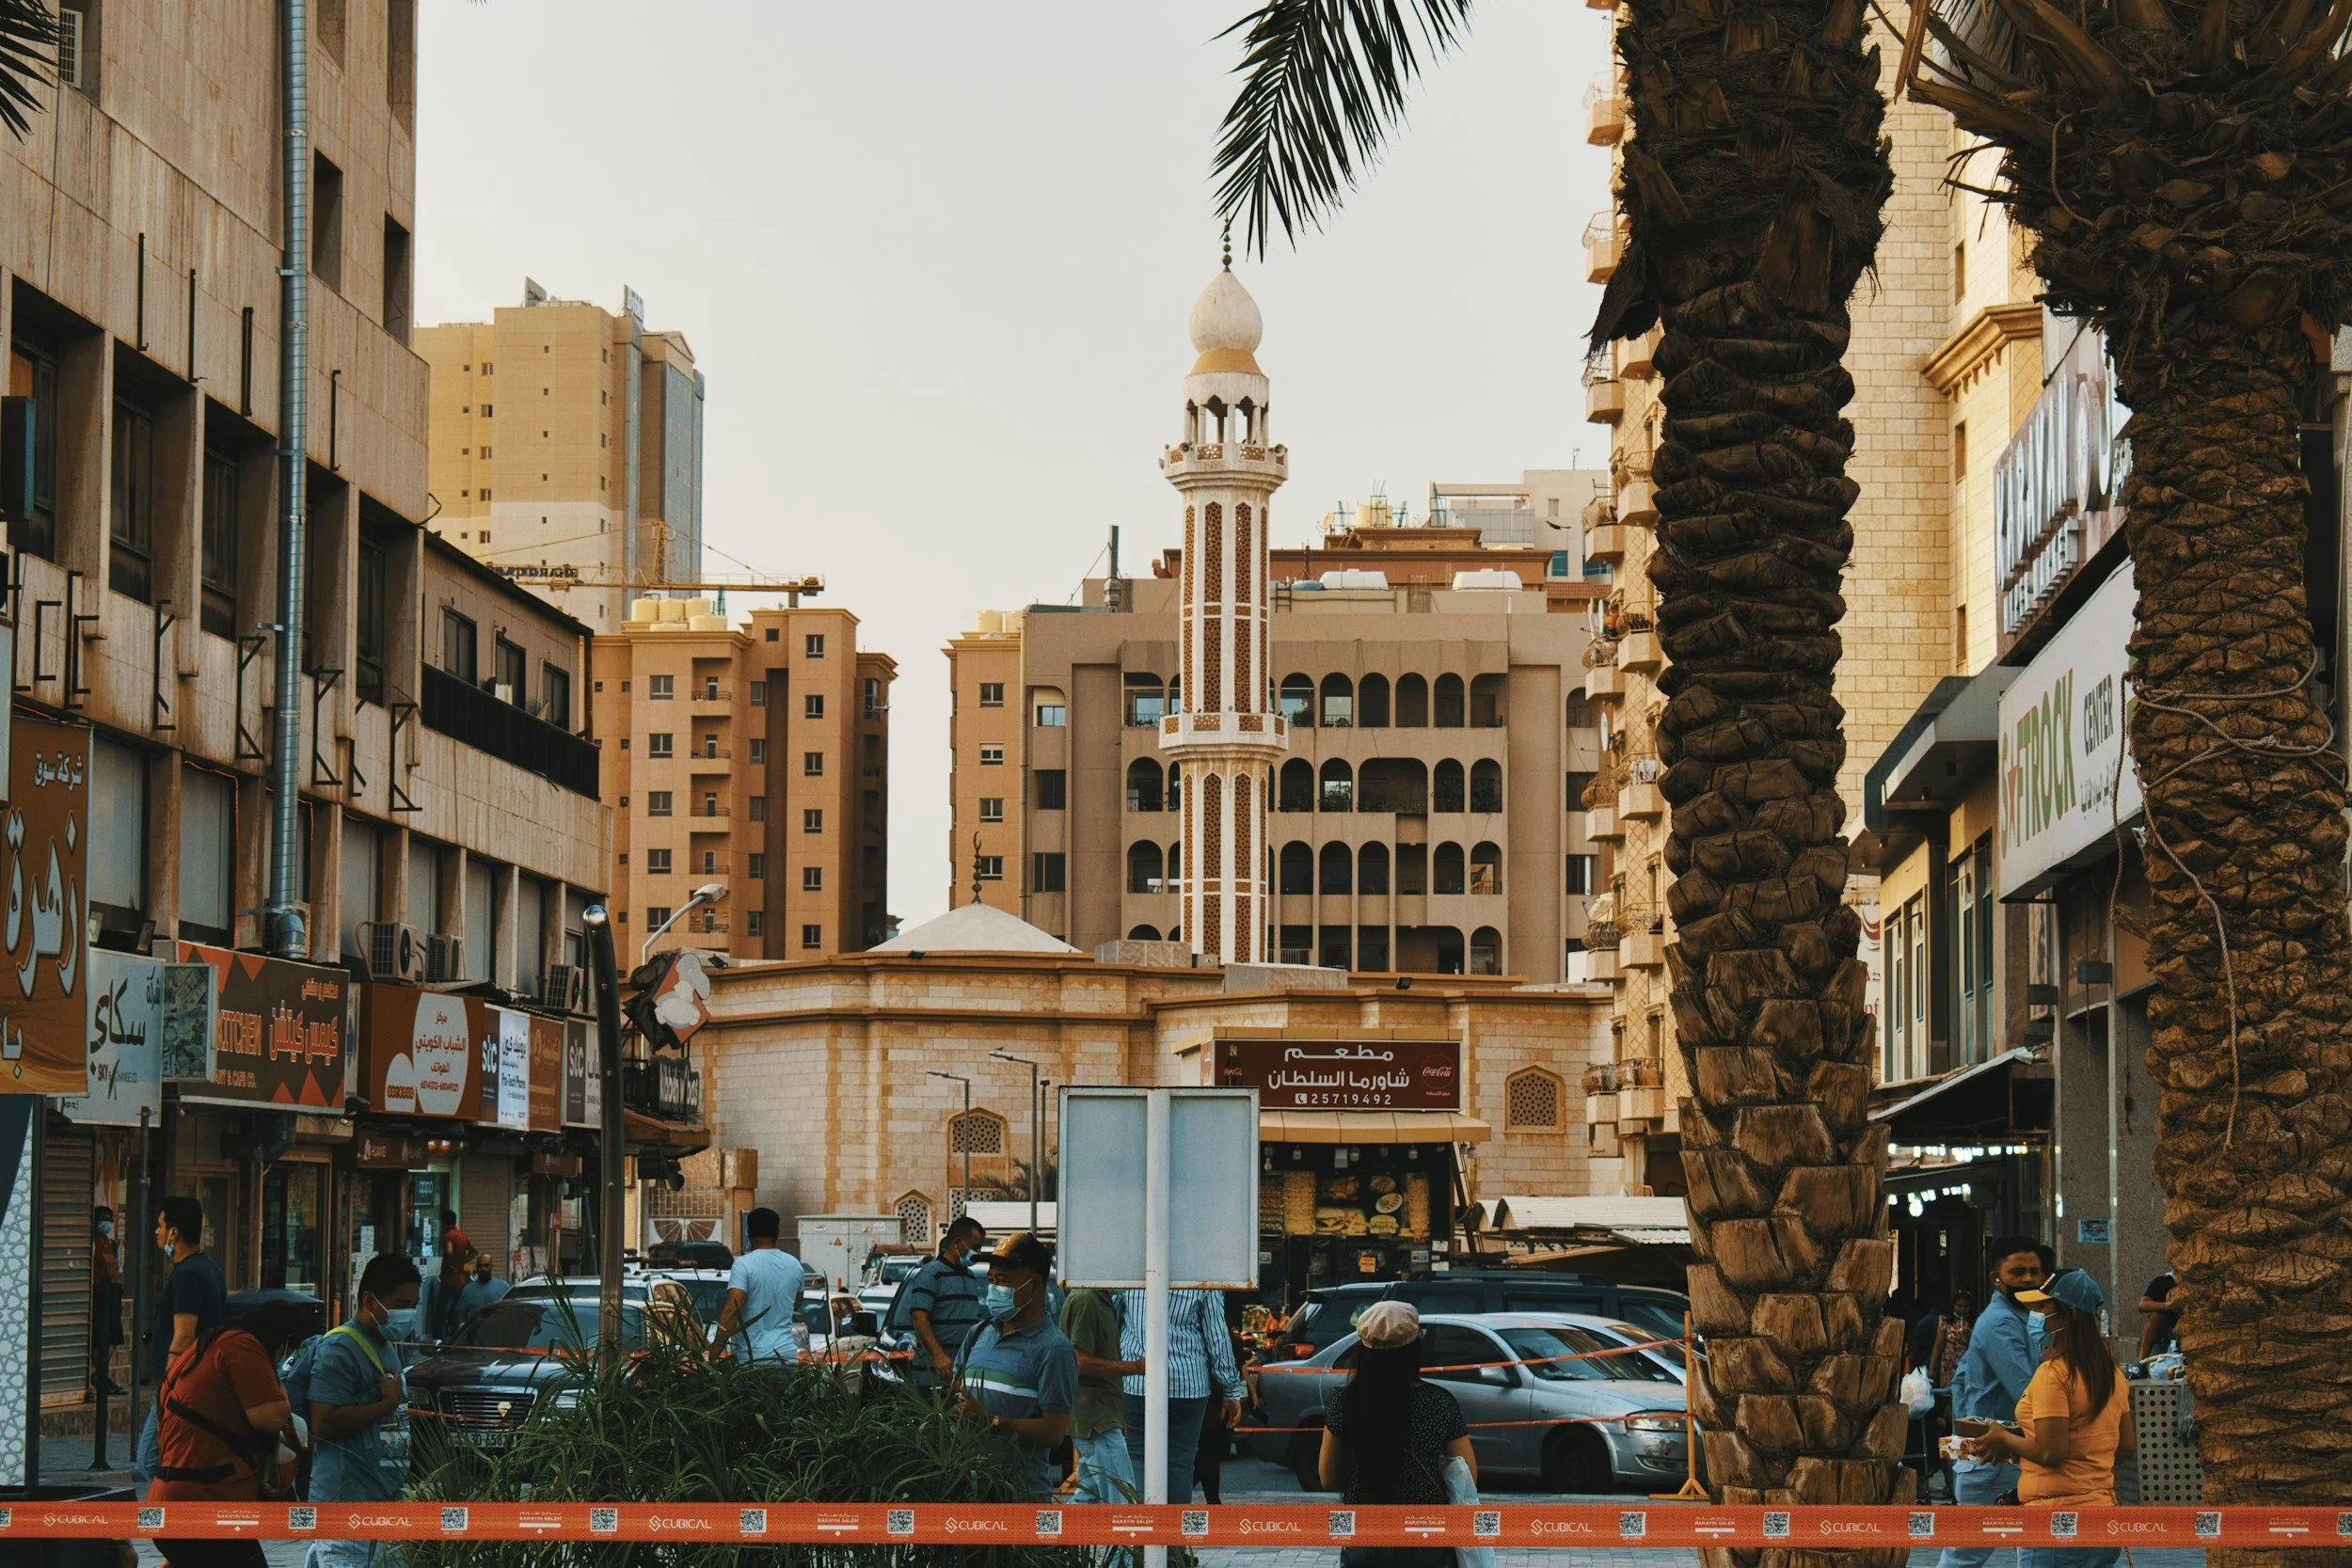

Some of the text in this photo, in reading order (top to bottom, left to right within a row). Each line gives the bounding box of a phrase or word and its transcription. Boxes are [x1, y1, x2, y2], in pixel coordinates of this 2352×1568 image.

[2084, 673, 2114, 756] CENTER
[33, 752, 84, 792] شركة سوق
[6, 806, 78, 1001] زهرة
[435, 1009, 449, 1025] مركز
[415, 1033, 467, 1055] الشباب الكويتي
[481, 1034, 498, 1075] stc
[568, 1037, 584, 1078] stc
[1283, 1044, 1394, 1062] مطعم
[1267, 1067, 1410, 1091] شاورما السلطان
[1311, 1092, 1391, 1105] 25719492
[57, 1514, 109, 1525] CUBICAL
[362, 1516, 412, 1527] CUBICAL
[662, 1518, 712, 1529] CUBICAL
[958, 1520, 1008, 1530] CUBICAL
[1252, 1521, 1301, 1531] CUBICAL
[1544, 1522, 1592, 1532] CUBICAL
[1833, 1522, 1881, 1533] CUBICAL
[2120, 1522, 2168, 1532] CUBICAL
